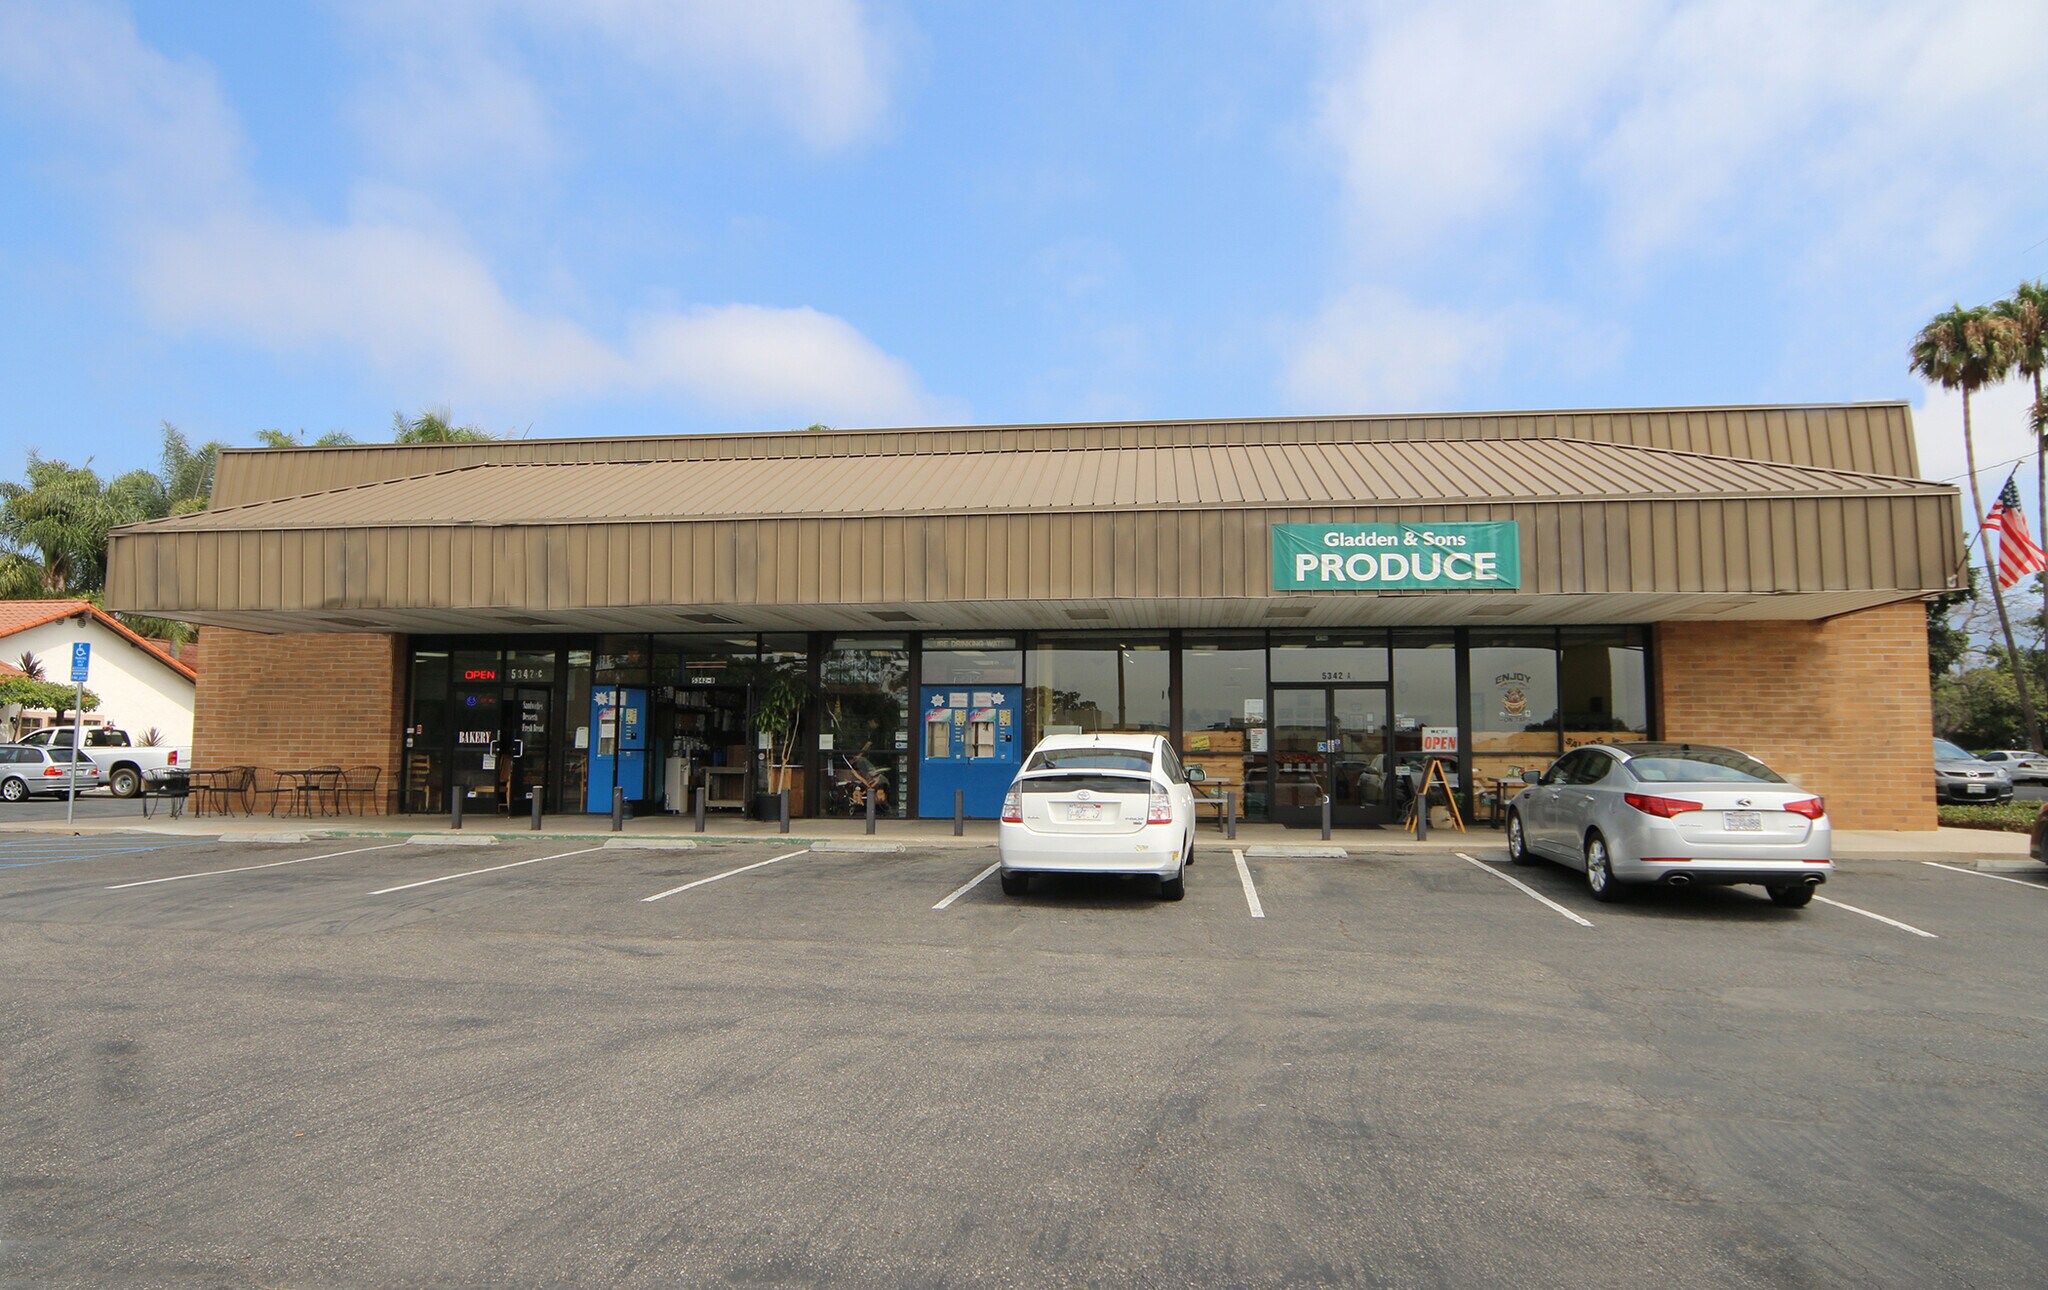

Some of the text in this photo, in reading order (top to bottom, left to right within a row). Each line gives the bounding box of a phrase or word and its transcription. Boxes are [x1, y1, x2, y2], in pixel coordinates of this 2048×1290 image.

[1323, 531, 1466, 547] Gladden & Sons
[1295, 552, 1498, 582] PRODUCE
[951, 640, 985, 648] DRINKING
[465, 669, 496, 680] OPEN
[1321, 671, 1343, 680] 5342
[1495, 672, 1532, 684] ENJOY
[459, 731, 492, 744] BAKERY
[1424, 736, 1457, 750] OPEN
